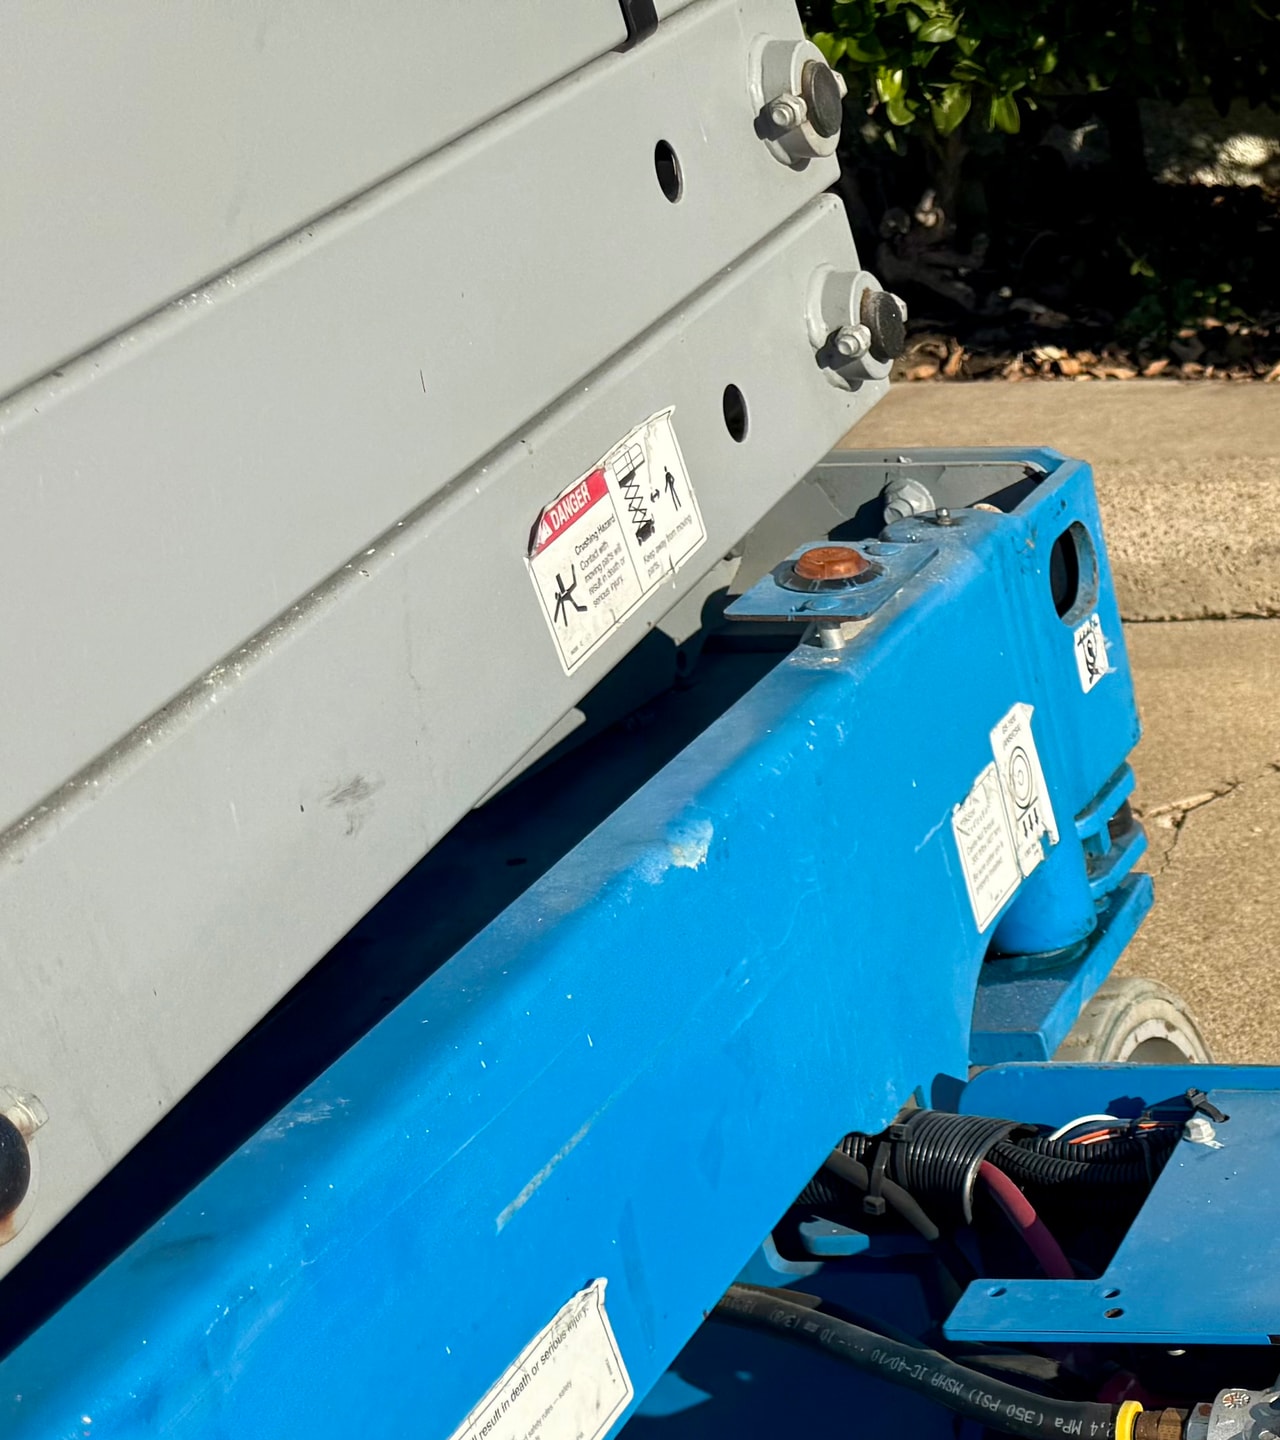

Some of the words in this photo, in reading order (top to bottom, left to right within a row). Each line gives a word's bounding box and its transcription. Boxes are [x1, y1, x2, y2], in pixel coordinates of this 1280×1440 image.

[548, 480, 592, 531] DANGER
[575, 530, 599, 556] Crushing
[597, 513, 615, 534] Hazard
[478, 1407, 501, 1440] result
[501, 1399, 510, 1413] in
[510, 1373, 531, 1402] death
[531, 1361, 539, 1376] or
[540, 1329, 566, 1365] serious
[968, 1388, 1001, 1411] PSI)
[1006, 1404, 1044, 1426] (350
[1054, 1417, 1082, 1436] MPa
